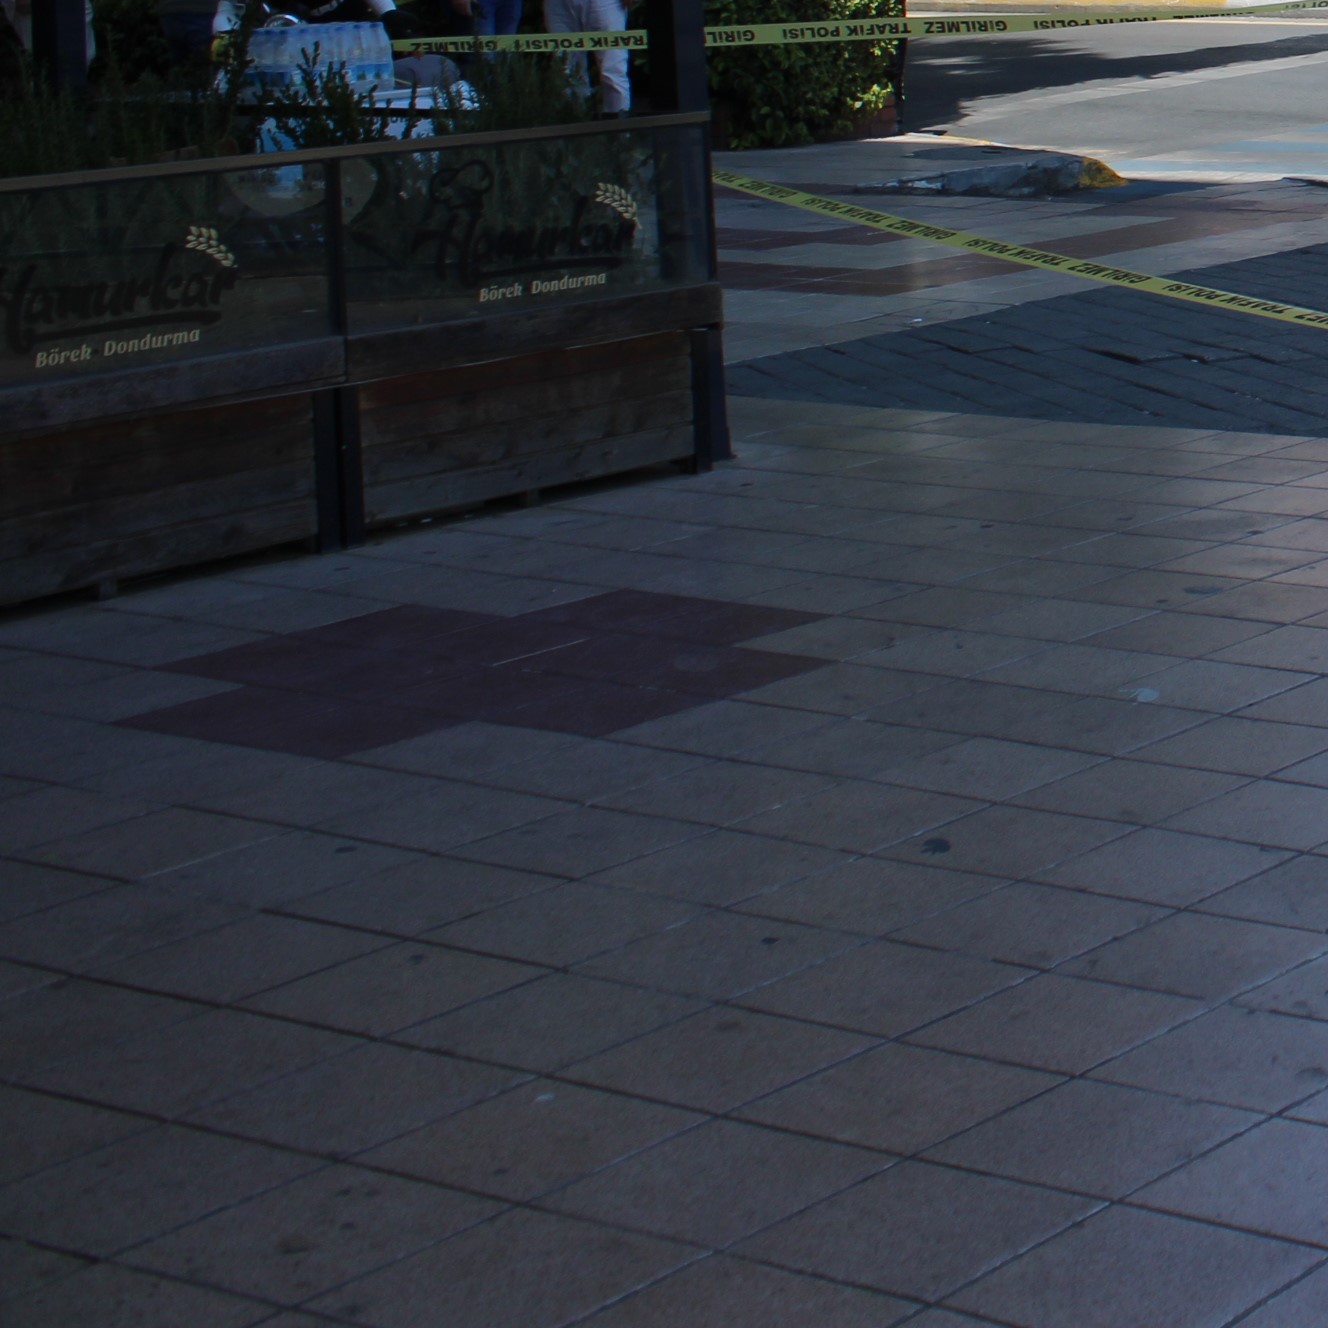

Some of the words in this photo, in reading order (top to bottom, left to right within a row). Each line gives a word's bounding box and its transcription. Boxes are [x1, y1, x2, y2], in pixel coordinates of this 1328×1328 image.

[591, 35, 646, 48] RAFİK
[707, 29, 755, 43] GİRİL
[479, 281, 524, 303] Börek
[532, 272, 607, 296] Dondurma
[35, 341, 93, 369] Börek
[104, 327, 200, 357] Dondurma
